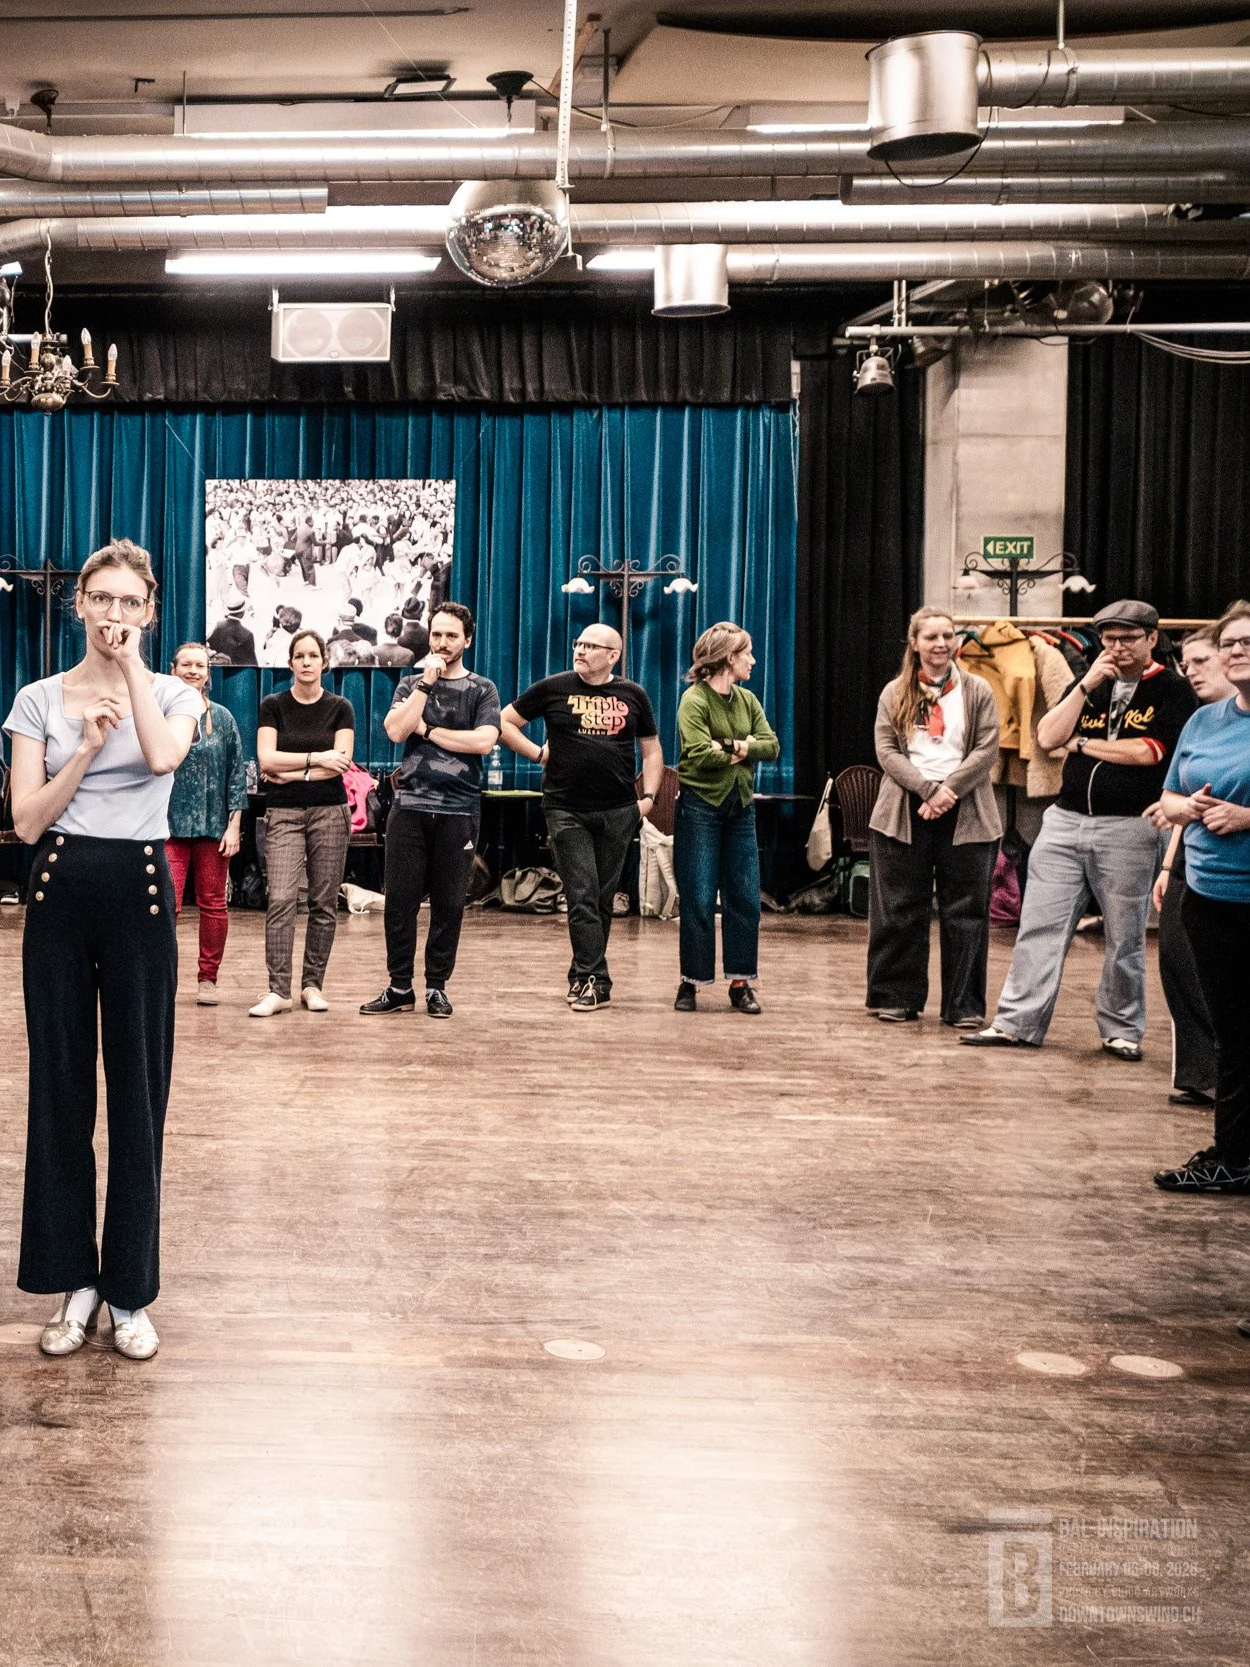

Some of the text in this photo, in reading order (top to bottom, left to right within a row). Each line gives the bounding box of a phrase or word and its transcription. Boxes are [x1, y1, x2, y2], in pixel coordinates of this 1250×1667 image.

[995, 541, 1031, 554] EXIT
[570, 695, 626, 714] Triple
[584, 712, 623, 731] step
